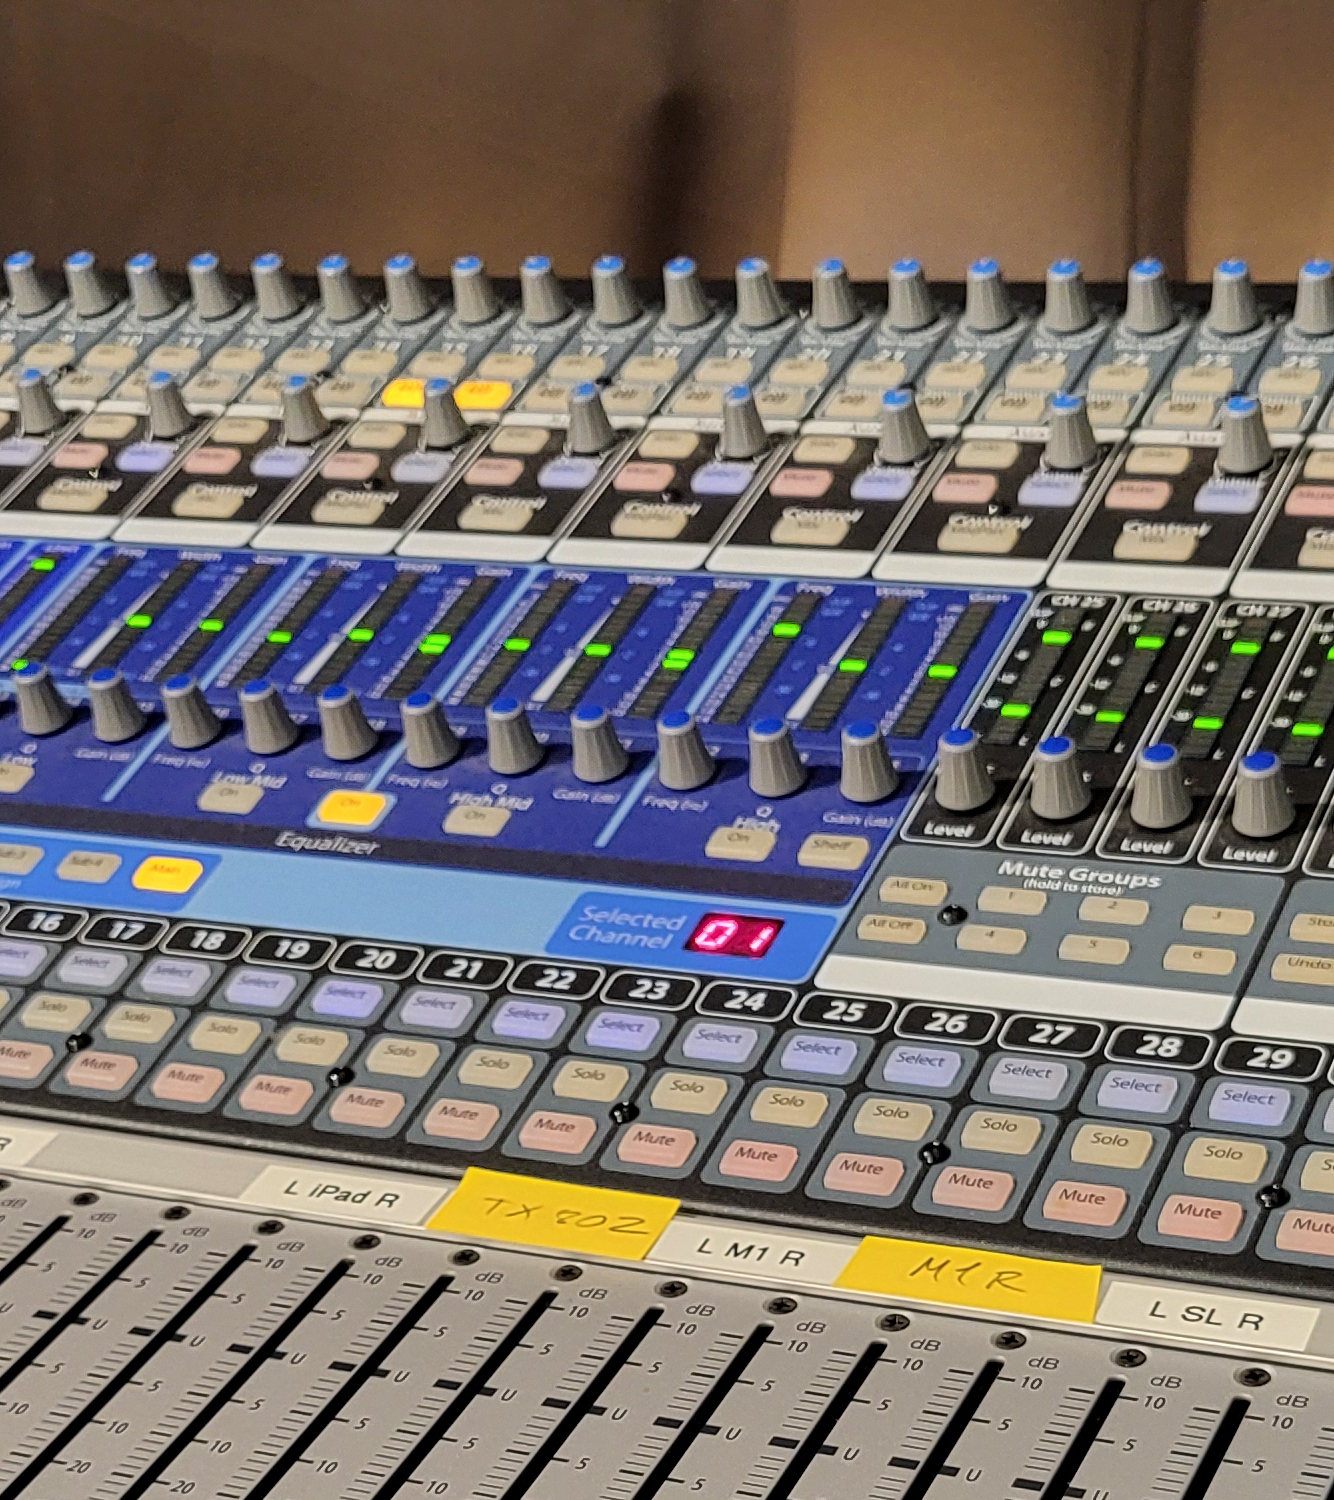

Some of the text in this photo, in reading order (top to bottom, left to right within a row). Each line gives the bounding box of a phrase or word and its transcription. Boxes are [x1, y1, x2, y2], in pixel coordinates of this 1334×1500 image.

[924, 822, 974, 839] Level
[275, 831, 378, 857] Equalizer
[1120, 838, 1172, 854] Level
[998, 860, 1162, 889] Mute Groups
[25, 913, 62, 933] 16
[581, 905, 687, 932] Selected
[108, 922, 143, 941] 17
[189, 930, 224, 951] 18
[569, 924, 675, 950] Channel
[692, 918, 773, 950] 01
[274, 940, 310, 960] 19
[360, 949, 398, 970] 20
[449, 960, 484, 979] 21
[1287, 958, 1332, 970] Undo
[538, 970, 576, 990] 22
[628, 980, 669, 1000] 23
[728, 989, 766, 1011] 24
[825, 1001, 866, 1022] 25
[925, 1013, 967, 1034] 26
[1027, 1024, 1071, 1045] 27
[1136, 1035, 1182, 1057] 28
[1247, 1046, 1295, 1070] 29
[283, 1180, 401, 1209] L iPad R
[696, 1237, 806, 1267] L M1 R
[909, 1256, 1026, 1293] M1 R
[1148, 1300, 1265, 1331] L SL R
